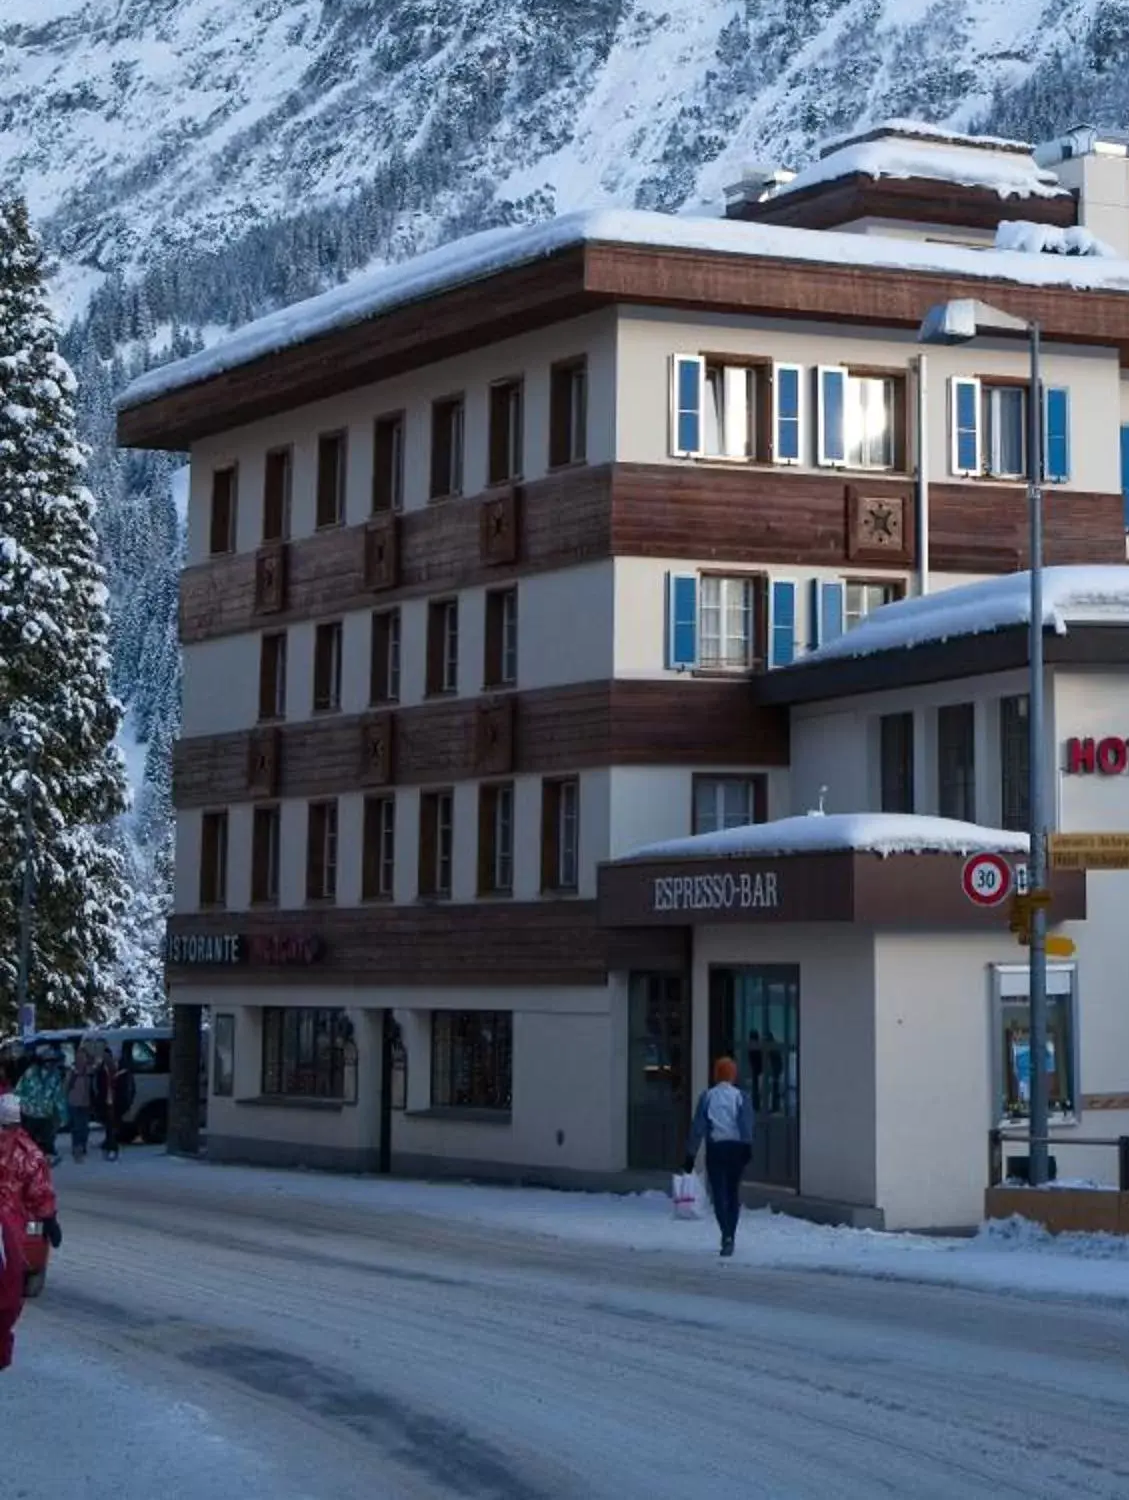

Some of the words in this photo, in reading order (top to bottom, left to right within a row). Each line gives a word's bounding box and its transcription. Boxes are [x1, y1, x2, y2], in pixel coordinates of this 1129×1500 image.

[655, 872, 778, 911] ESPRESSO-BAR
[977, 869, 996, 889] 30
[163, 933, 240, 963] ISTORANTE
